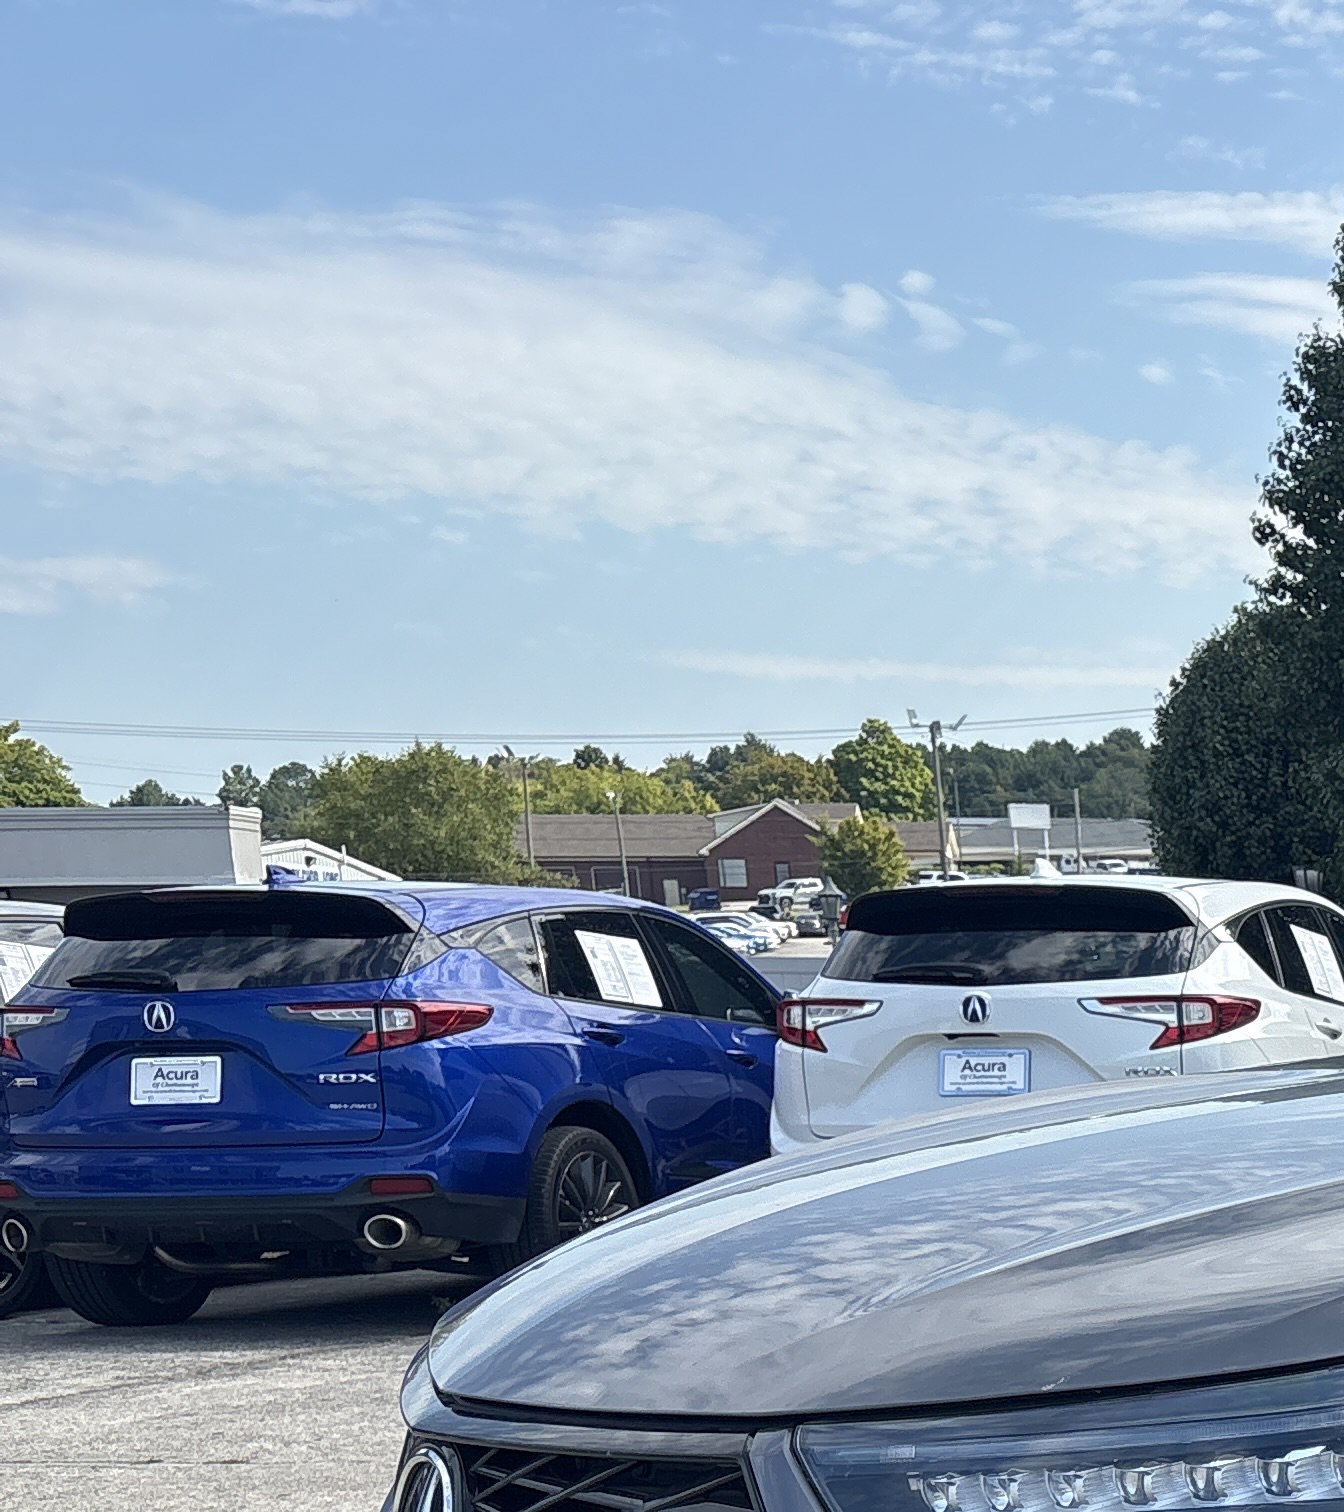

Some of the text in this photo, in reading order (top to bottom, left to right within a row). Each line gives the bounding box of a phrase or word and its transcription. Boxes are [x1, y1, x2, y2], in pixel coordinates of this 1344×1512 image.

[960, 1059, 1007, 1073] Acura
[152, 1066, 199, 1081] Acura
[318, 1072, 377, 1084] RDX
